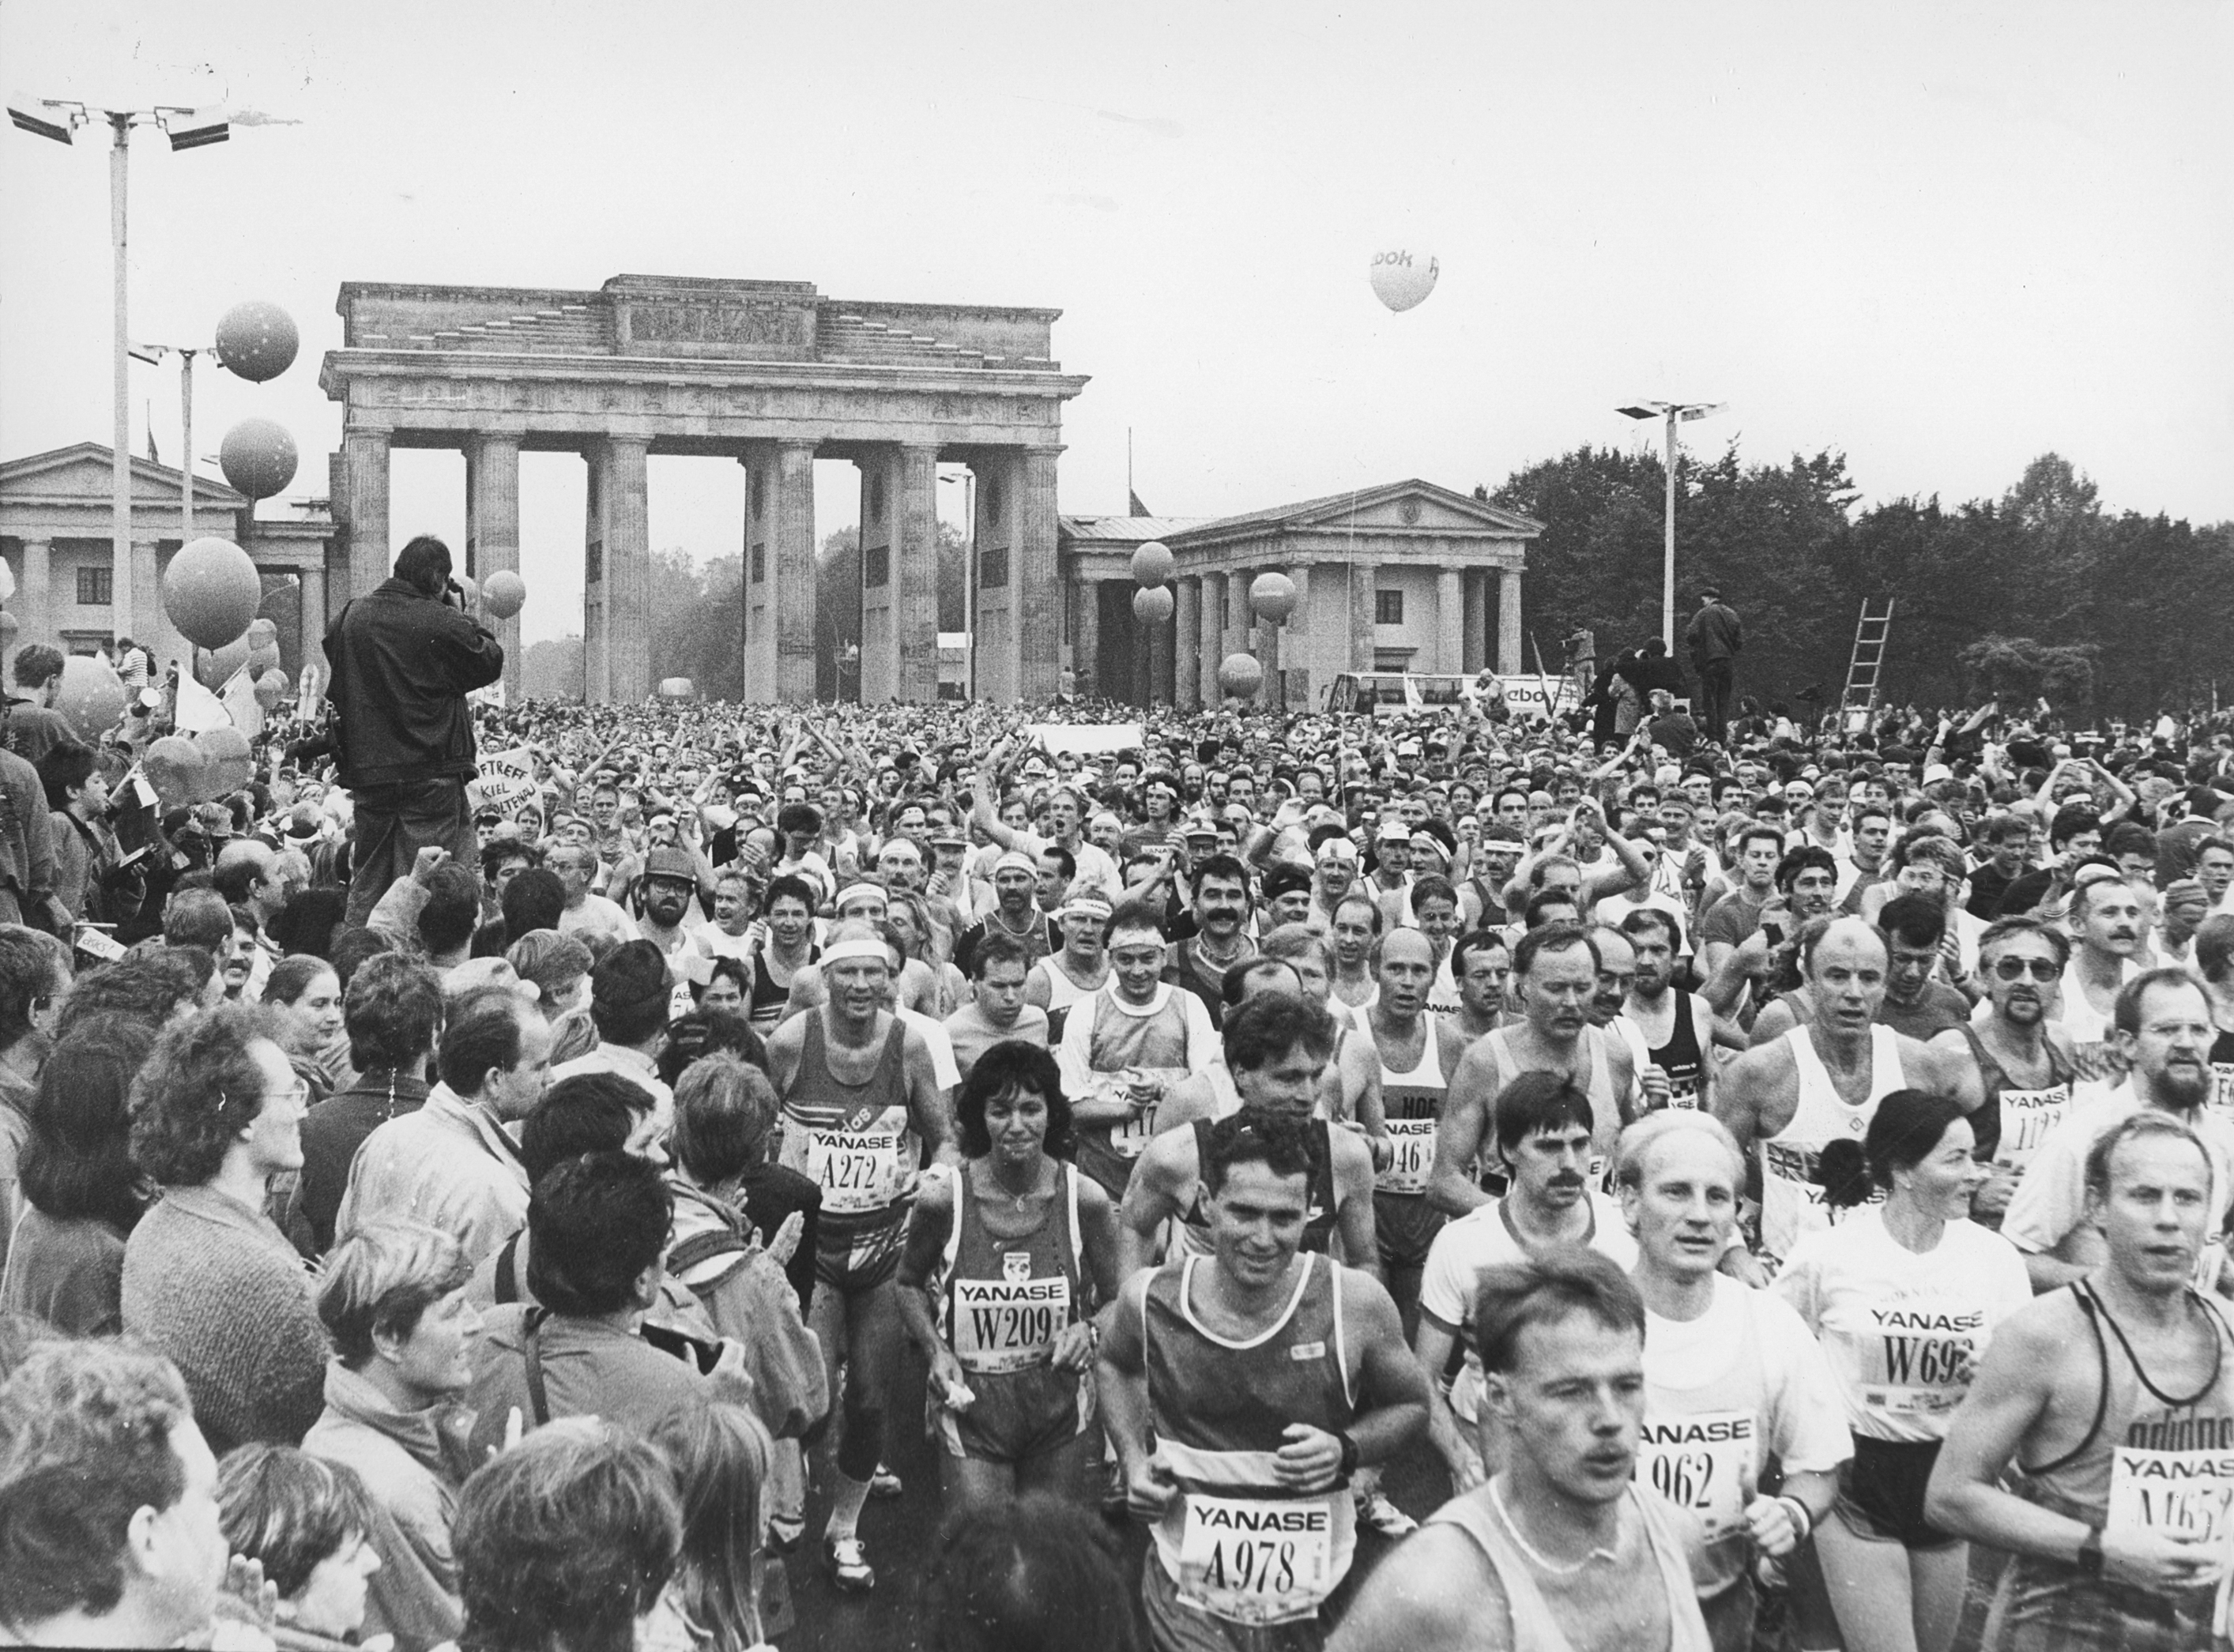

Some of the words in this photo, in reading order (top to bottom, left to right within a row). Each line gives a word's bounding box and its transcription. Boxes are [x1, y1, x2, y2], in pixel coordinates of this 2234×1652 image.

[480, 782, 510, 798] KIEL
[813, 1132, 893, 1150] YANASE
[820, 1153, 876, 1189] A272
[959, 1283, 1064, 1302] YANASE
[970, 1306, 1052, 1350] W209
[1870, 1308, 1983, 1333] YANASE
[1883, 1334, 1974, 1384] W69
[1639, 1419, 1751, 1445] ANASE
[1194, 1505, 1328, 1532] YANASE
[1203, 1539, 1295, 1594] A978
